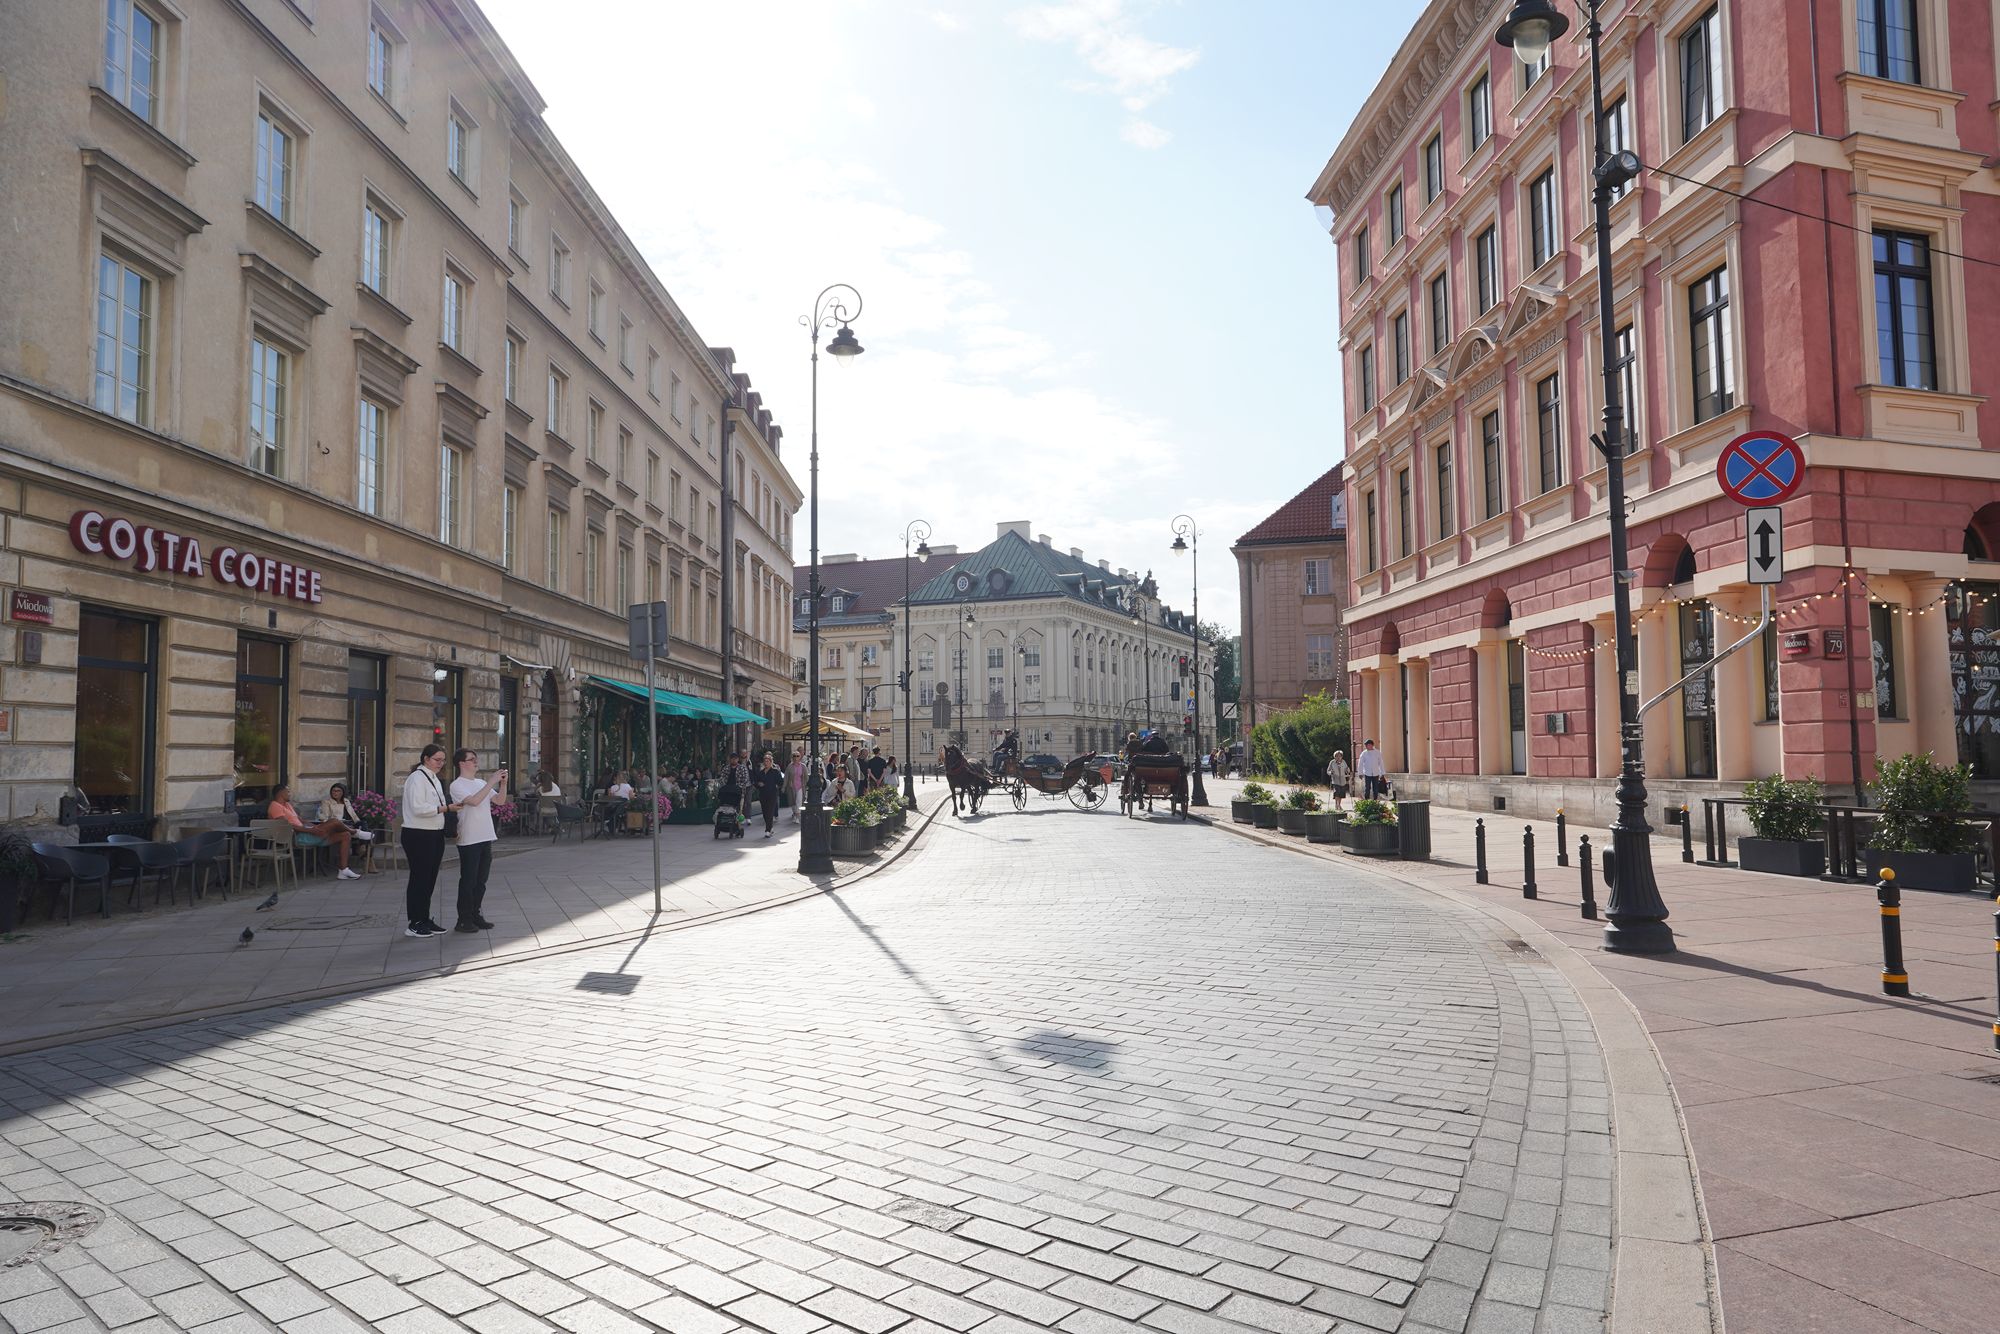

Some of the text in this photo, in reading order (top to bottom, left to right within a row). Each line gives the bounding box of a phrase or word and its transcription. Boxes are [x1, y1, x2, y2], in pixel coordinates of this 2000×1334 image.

[69, 510, 322, 604] COSTA COFFEE
[16, 598, 53, 614] Miodowa
[1784, 639, 1807, 648] Miodowa
[1830, 640, 1843, 653] 79
